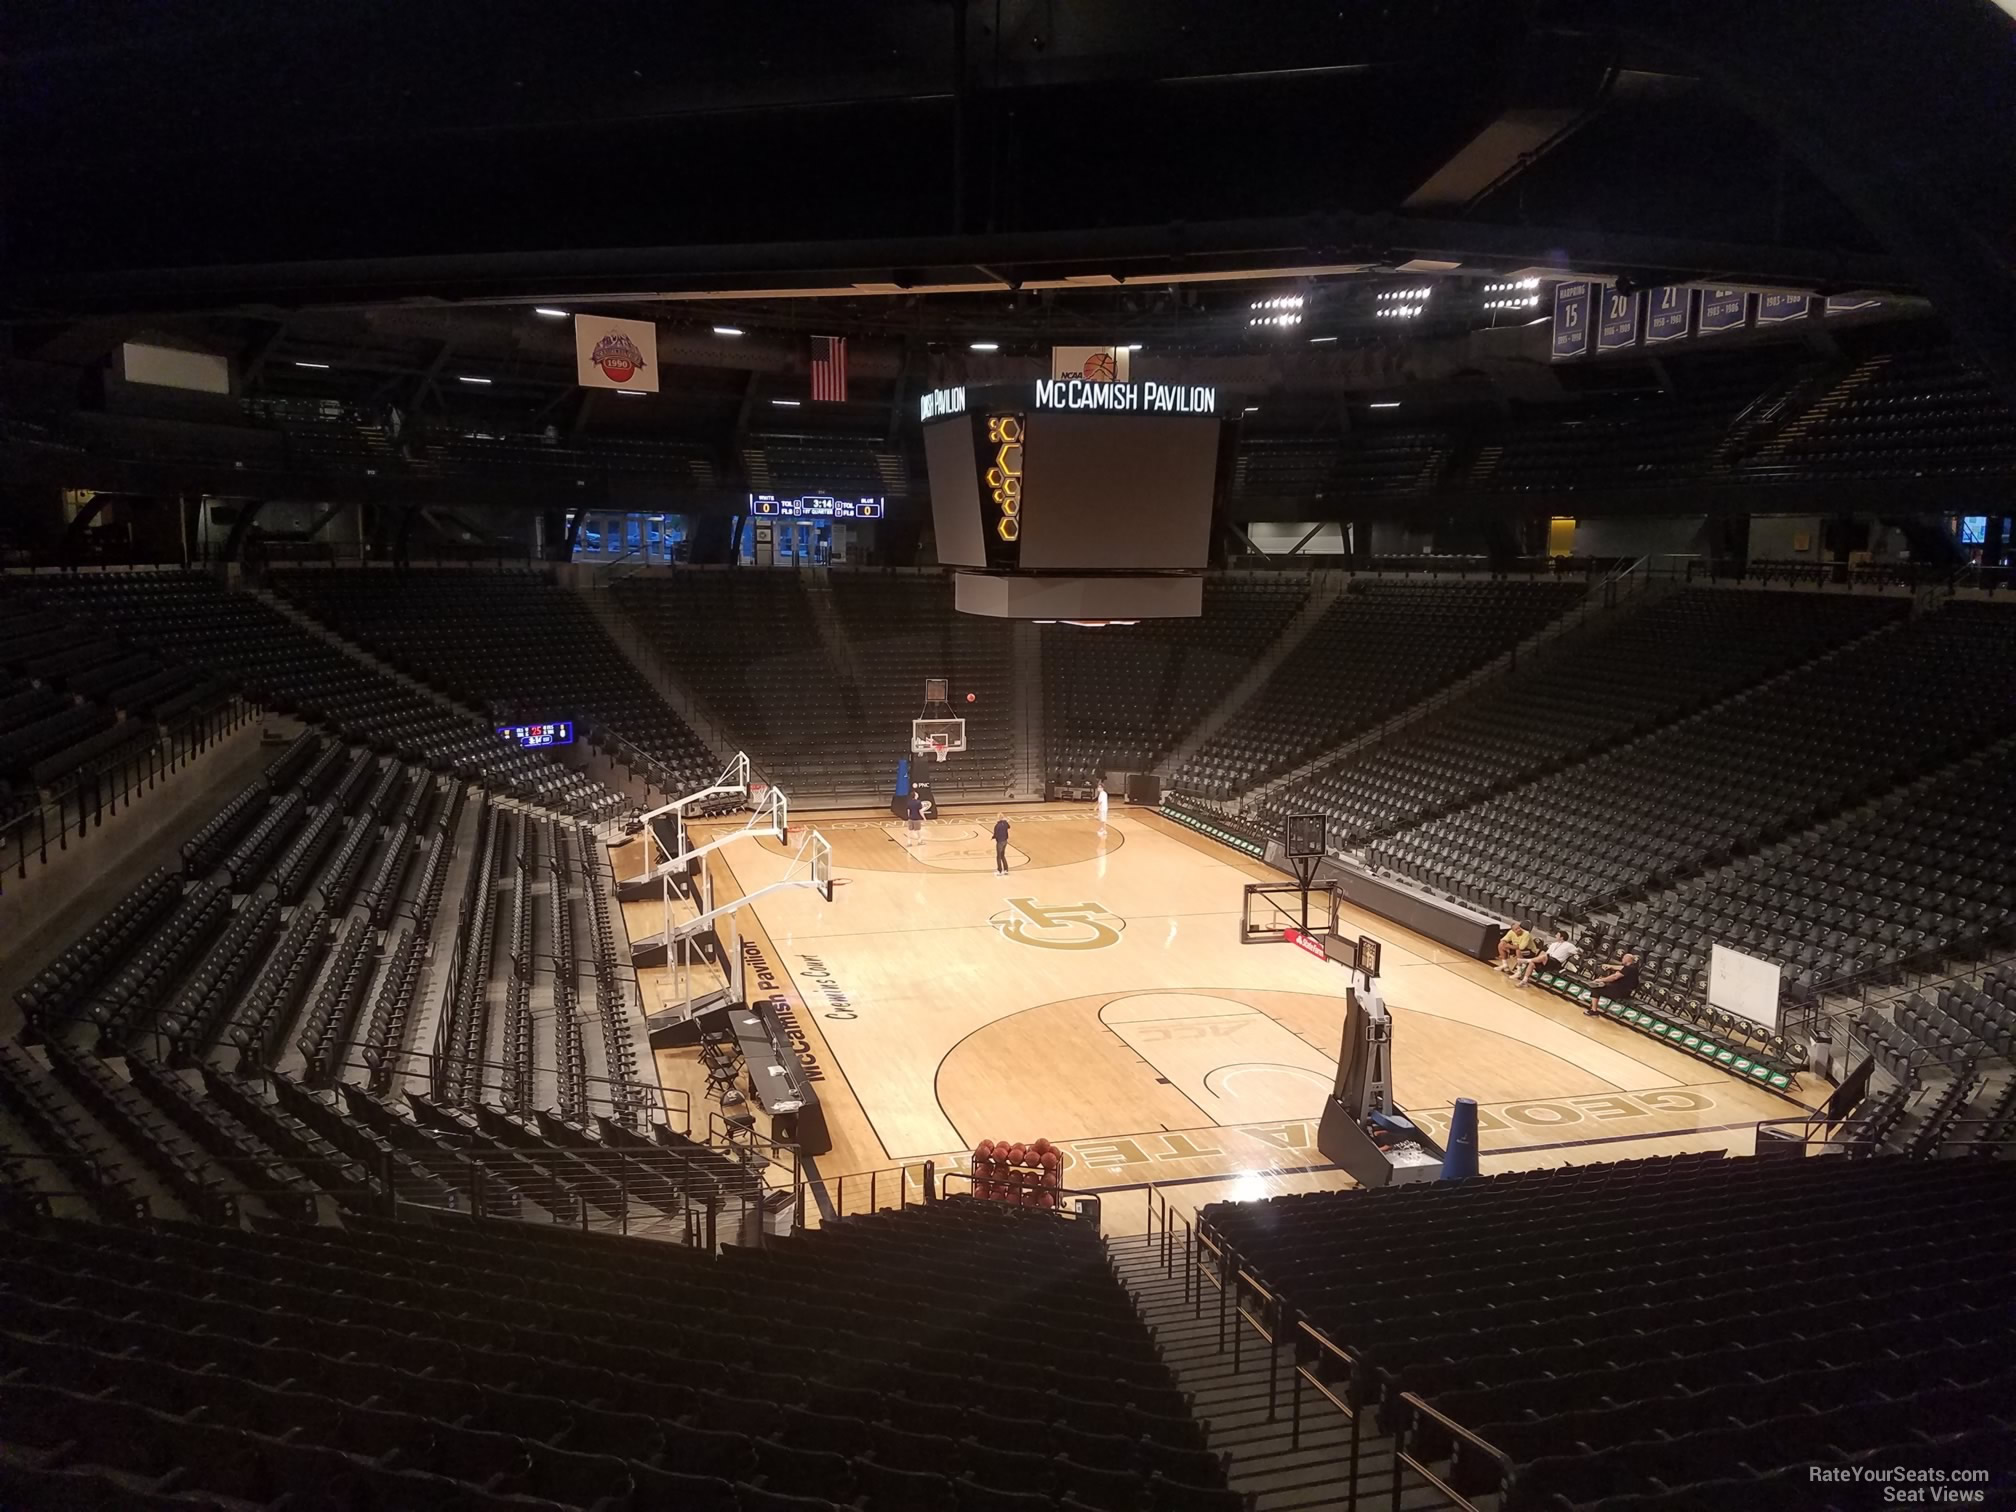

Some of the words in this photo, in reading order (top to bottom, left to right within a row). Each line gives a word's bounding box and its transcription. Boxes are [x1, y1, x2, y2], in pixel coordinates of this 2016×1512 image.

[1610, 295, 1627, 318] 20
[1661, 287, 1677, 309] 21
[1565, 303, 1578, 327] 15
[607, 359, 628, 368] 1990
[1061, 371, 1083, 379] NCAA
[934, 386, 966, 416] PAVILION
[1143, 381, 1215, 413] PAVILION
[763, 503, 770, 513] 0
[813, 499, 832, 508] 3:14
[864, 506, 871, 516] 0
[743, 940, 780, 991] Pavilion
[794, 953, 831, 978] Court
[812, 978, 859, 1020] Cremins
